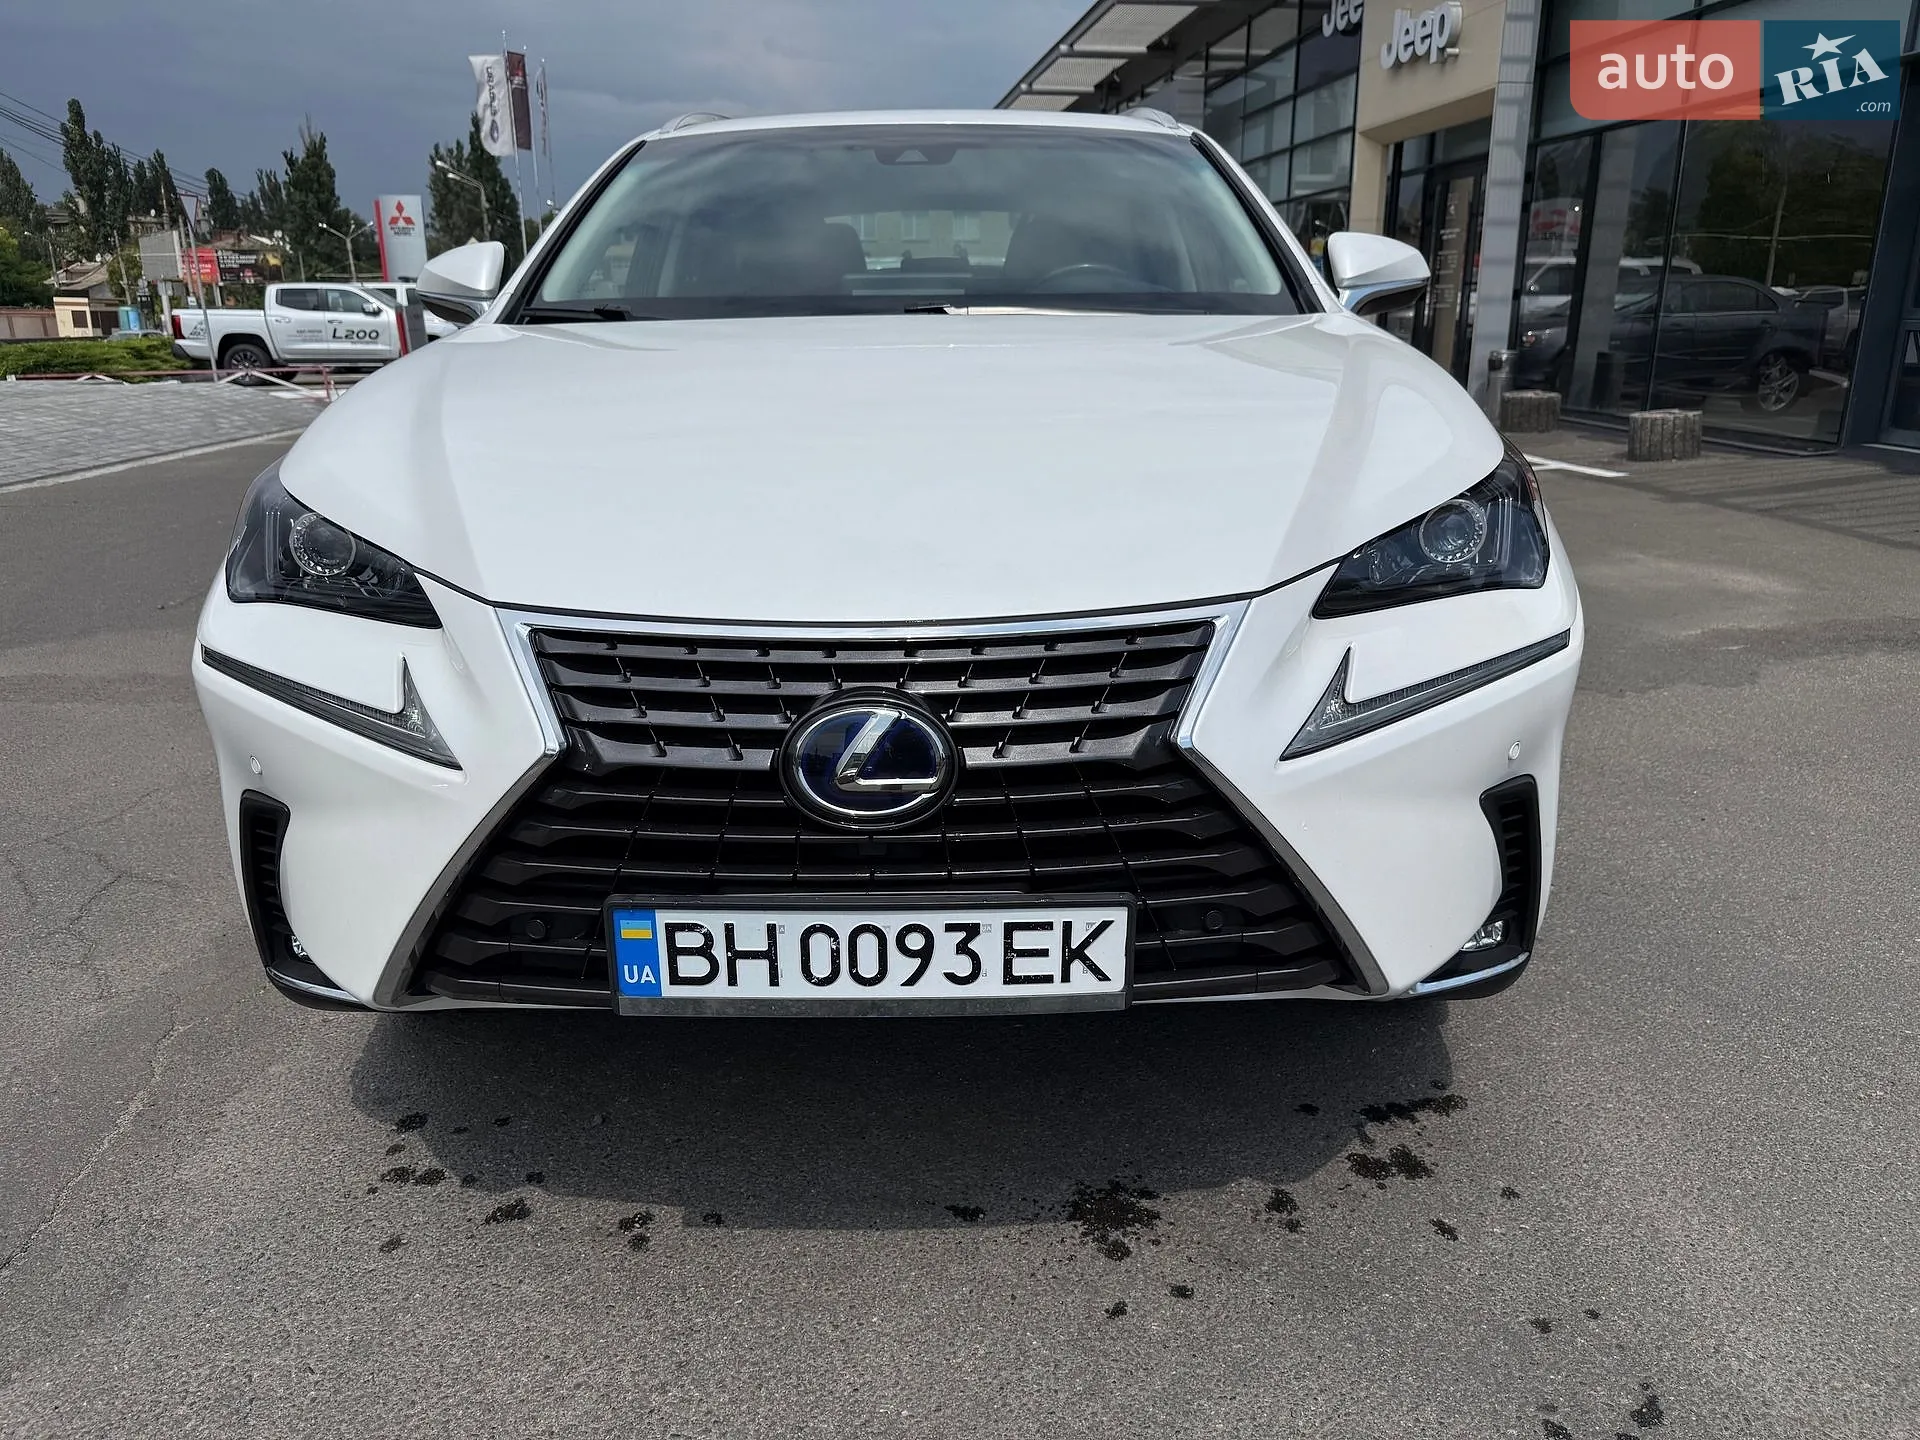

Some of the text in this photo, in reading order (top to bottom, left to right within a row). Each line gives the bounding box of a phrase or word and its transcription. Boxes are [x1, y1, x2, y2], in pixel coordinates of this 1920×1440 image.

[1322, 0, 1364, 38] Jee
[1380, 2, 1452, 70] Jeep
[332, 327, 380, 341] L200
[664, 919, 1115, 988] BH 0093 EK
[623, 964, 656, 984] UA
